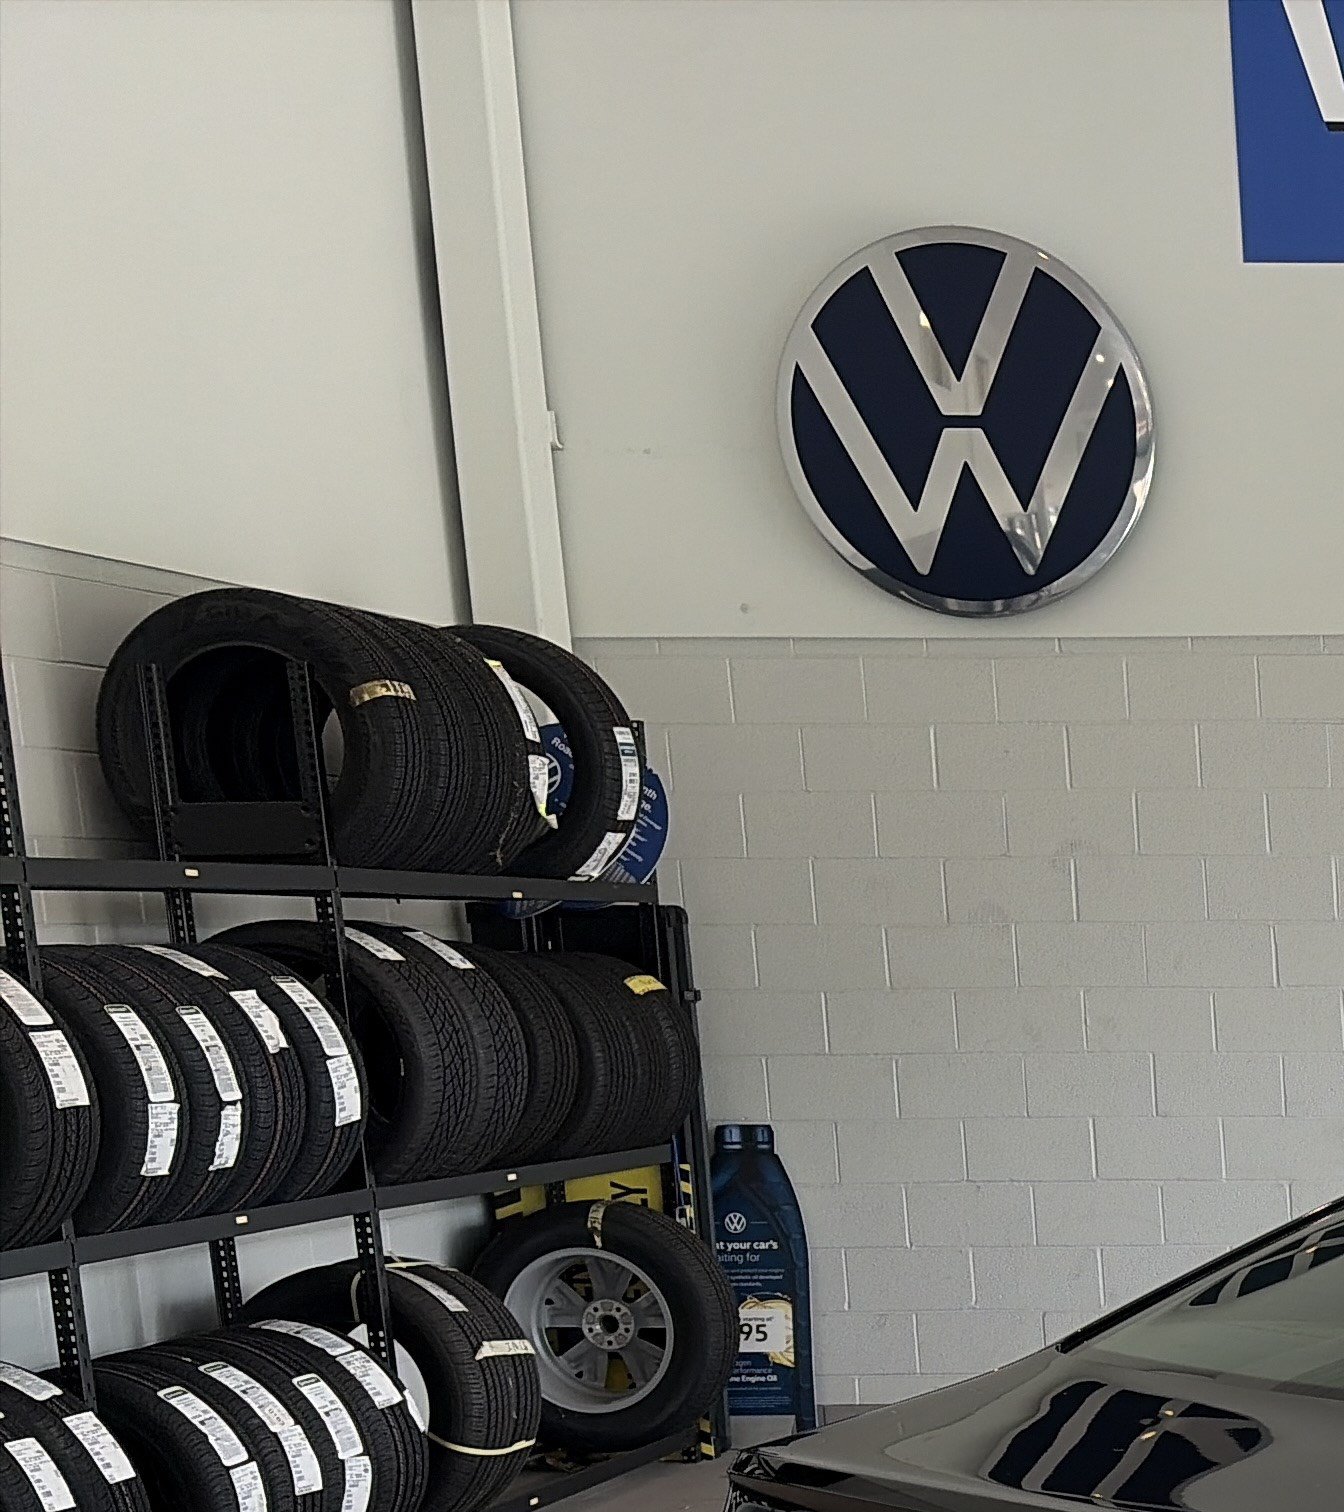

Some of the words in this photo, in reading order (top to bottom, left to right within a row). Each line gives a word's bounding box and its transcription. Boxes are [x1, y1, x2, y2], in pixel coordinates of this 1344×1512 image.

[726, 1241, 751, 1251] your
[753, 1240, 778, 1249] car's
[717, 1253, 743, 1264] aiting
[746, 1252, 760, 1261] for
